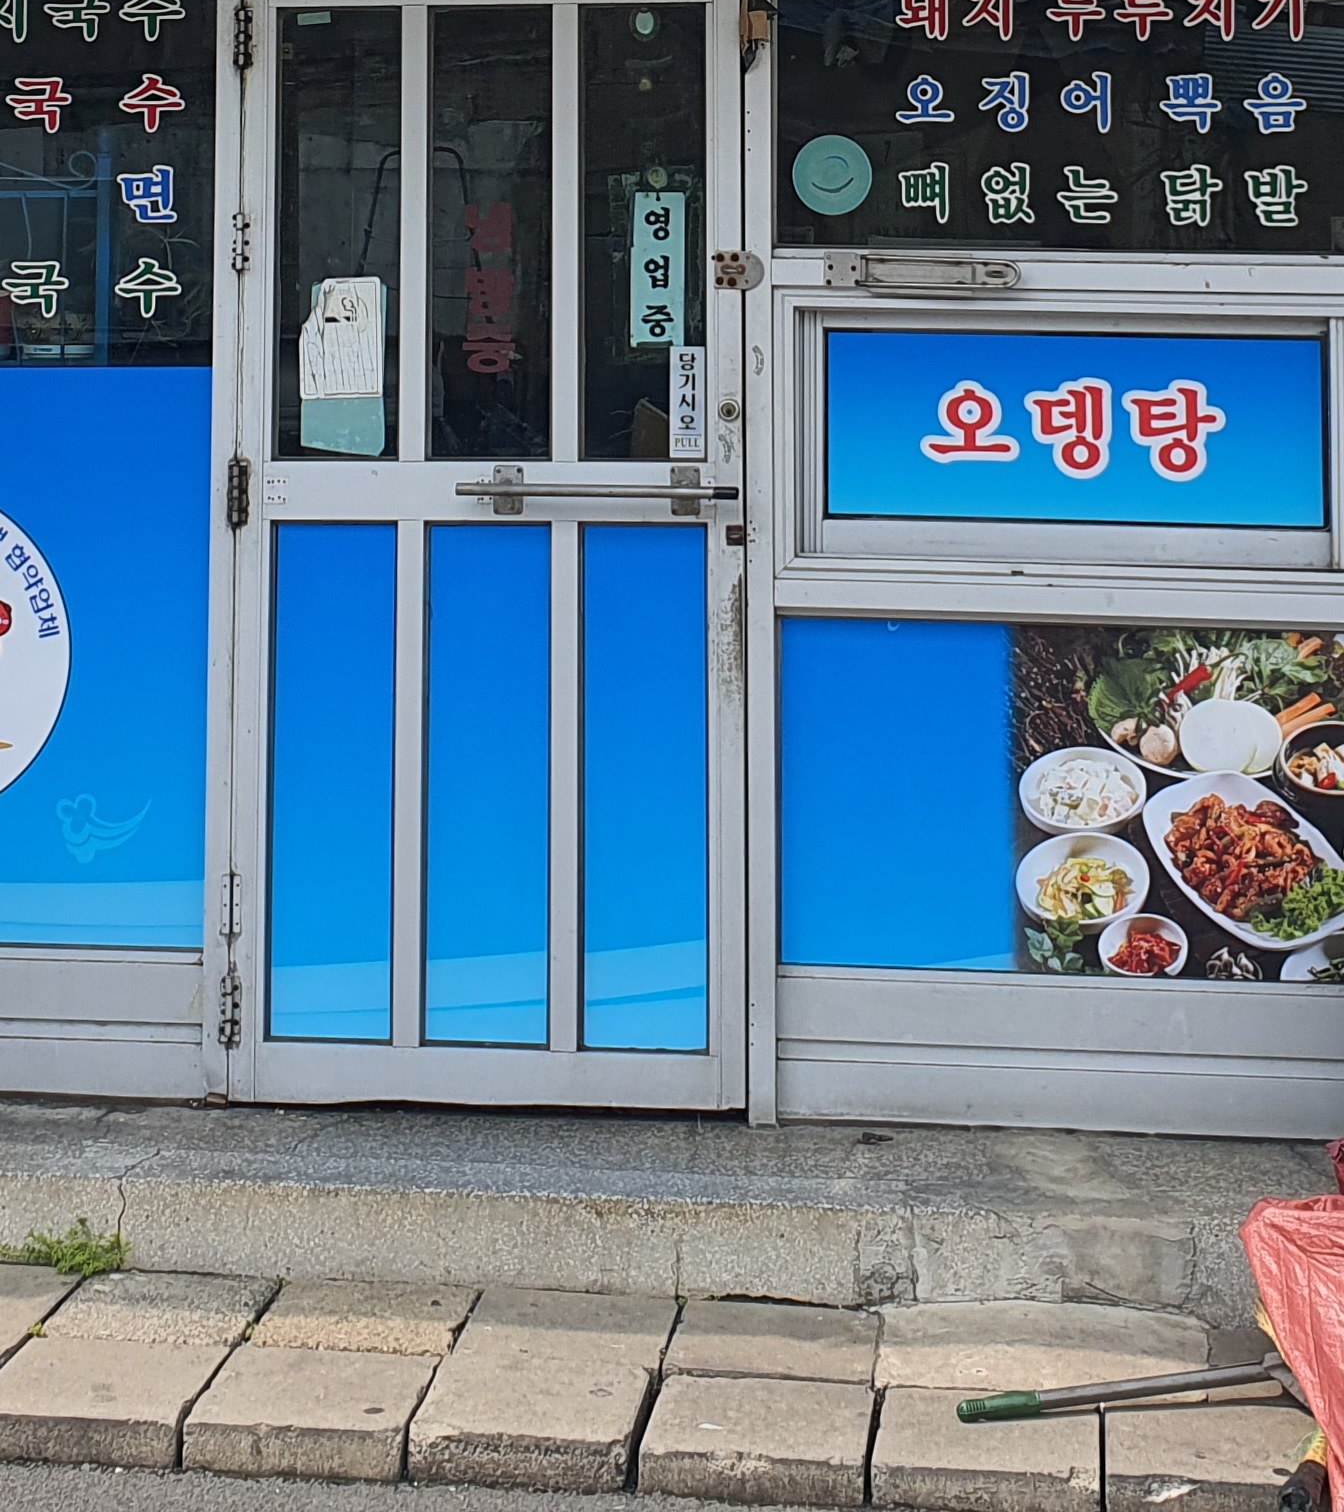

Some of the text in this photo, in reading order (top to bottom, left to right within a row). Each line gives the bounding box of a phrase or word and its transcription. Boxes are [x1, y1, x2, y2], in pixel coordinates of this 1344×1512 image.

[641, 206, 675, 339] 영업중
[676, 350, 699, 431] 당기시오
[922, 377, 1225, 481] 오뎅탕
[674, 436, 702, 450] PULL
[4, 542, 62, 640] 협약업체
